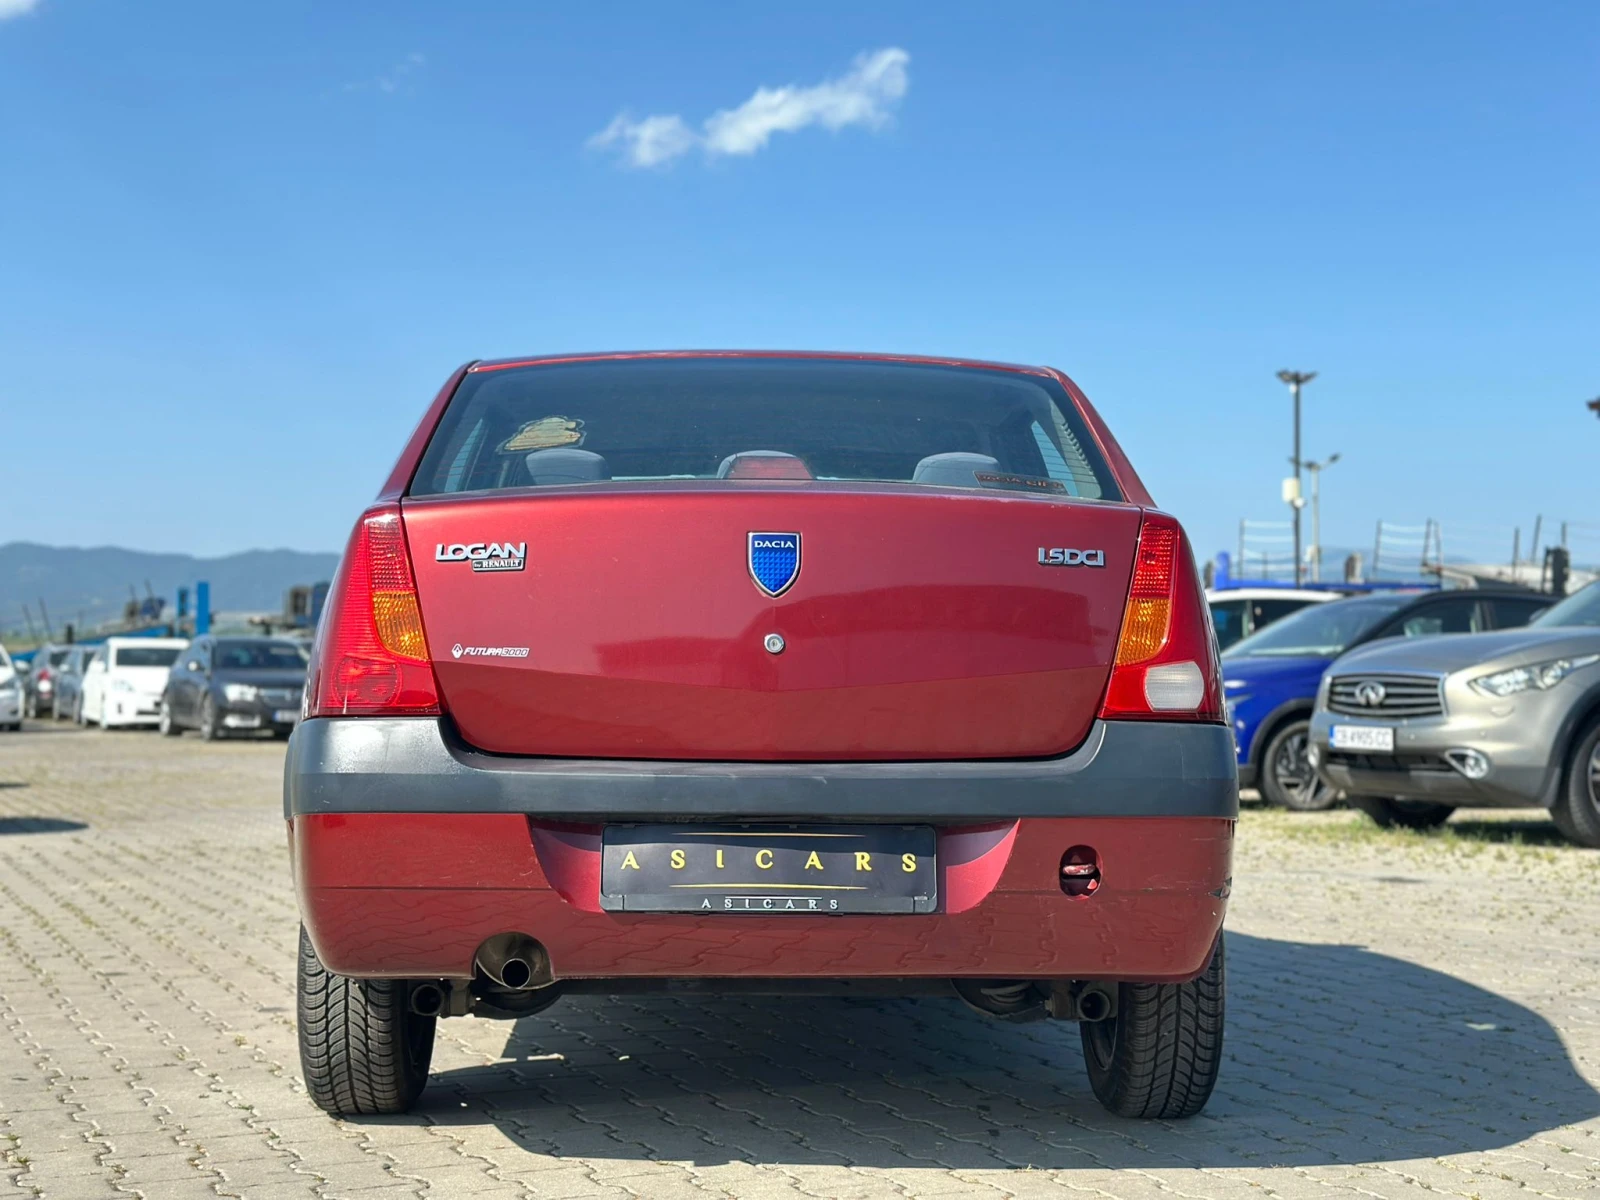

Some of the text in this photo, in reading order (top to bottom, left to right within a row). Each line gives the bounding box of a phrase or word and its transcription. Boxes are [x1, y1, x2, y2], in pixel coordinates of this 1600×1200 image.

[754, 540, 795, 549] DACIA
[435, 542, 526, 561] LOGAN
[482, 559, 520, 568] RENAULT
[620, 849, 917, 873] ASICARS
[701, 898, 838, 910] ASICARS
